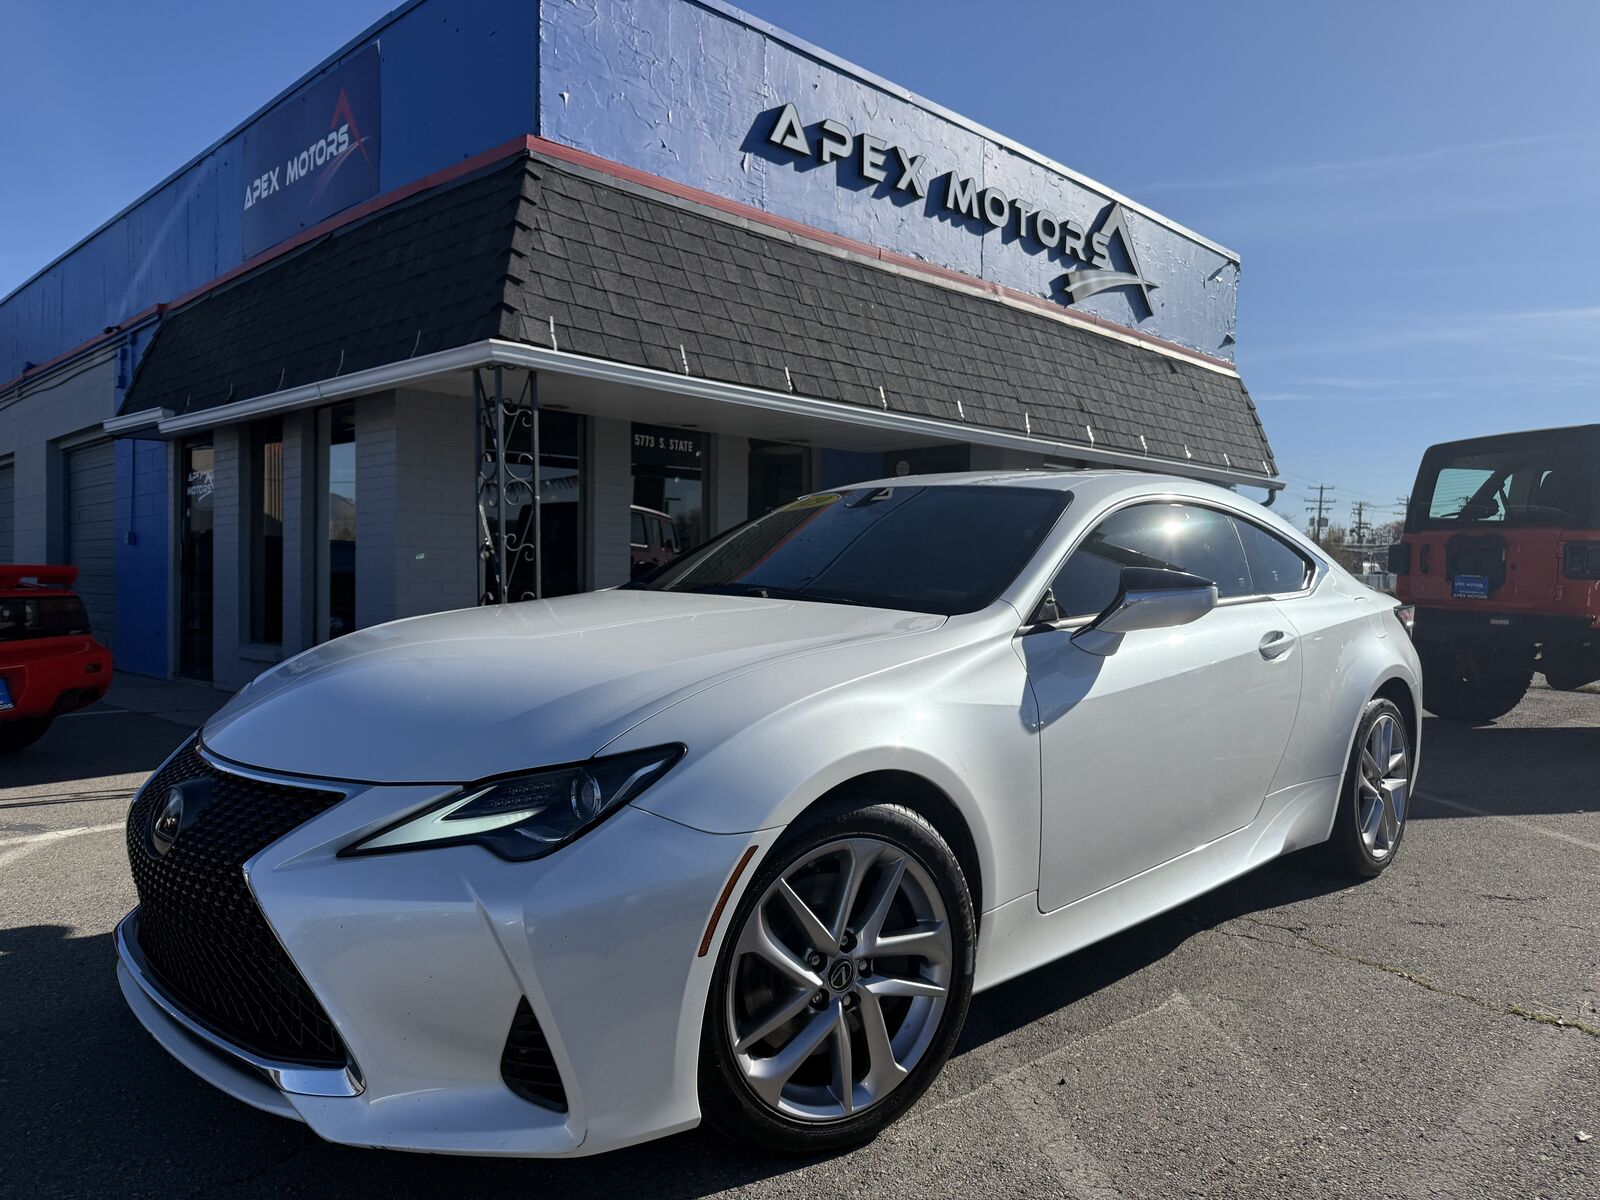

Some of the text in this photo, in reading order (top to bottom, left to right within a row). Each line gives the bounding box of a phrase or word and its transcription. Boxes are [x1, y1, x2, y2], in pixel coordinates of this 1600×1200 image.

[244, 123, 350, 210] APEX MOTORS
[770, 102, 1111, 267] APEX MOTORS
[634, 434, 655, 448] 5773
[669, 438, 694, 452] STATE
